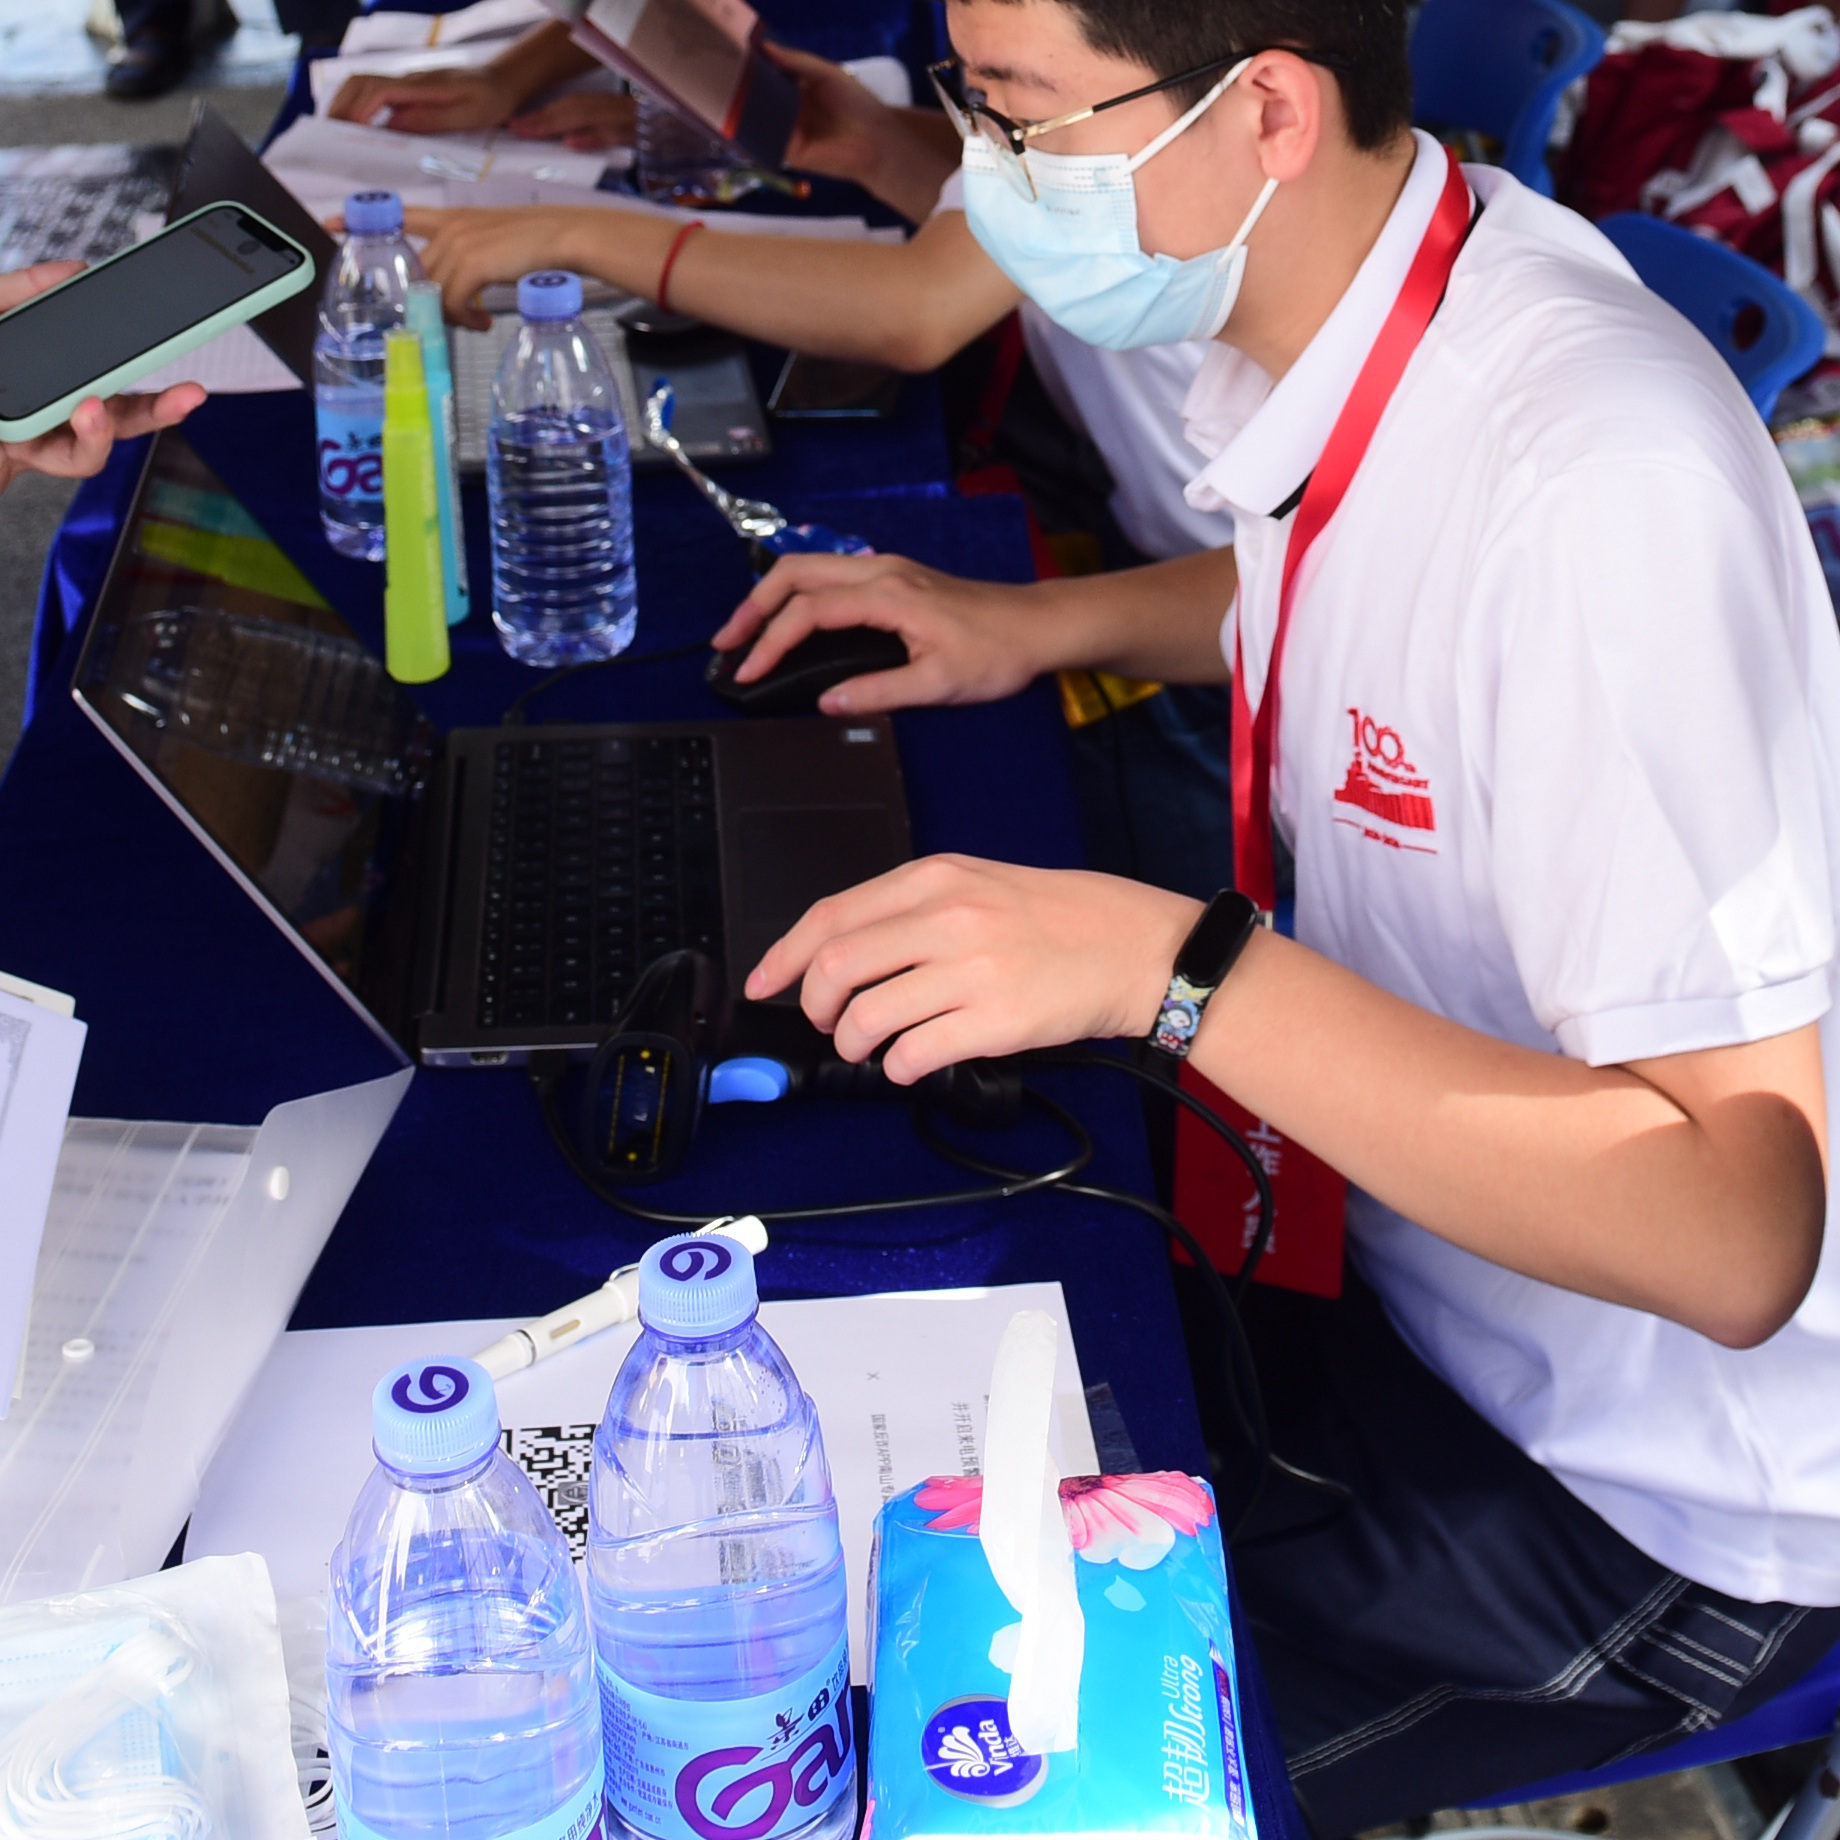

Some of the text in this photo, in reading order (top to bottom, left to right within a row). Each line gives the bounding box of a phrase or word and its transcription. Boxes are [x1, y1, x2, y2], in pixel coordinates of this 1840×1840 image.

[1161, 1655, 1180, 1698] Ultra
[1169, 1654, 1203, 1720] Strong
[978, 1719, 1013, 1775] Vinda
[1161, 1720, 1210, 1810] 超韧
[557, 1792, 601, 1840] 用纯净水
